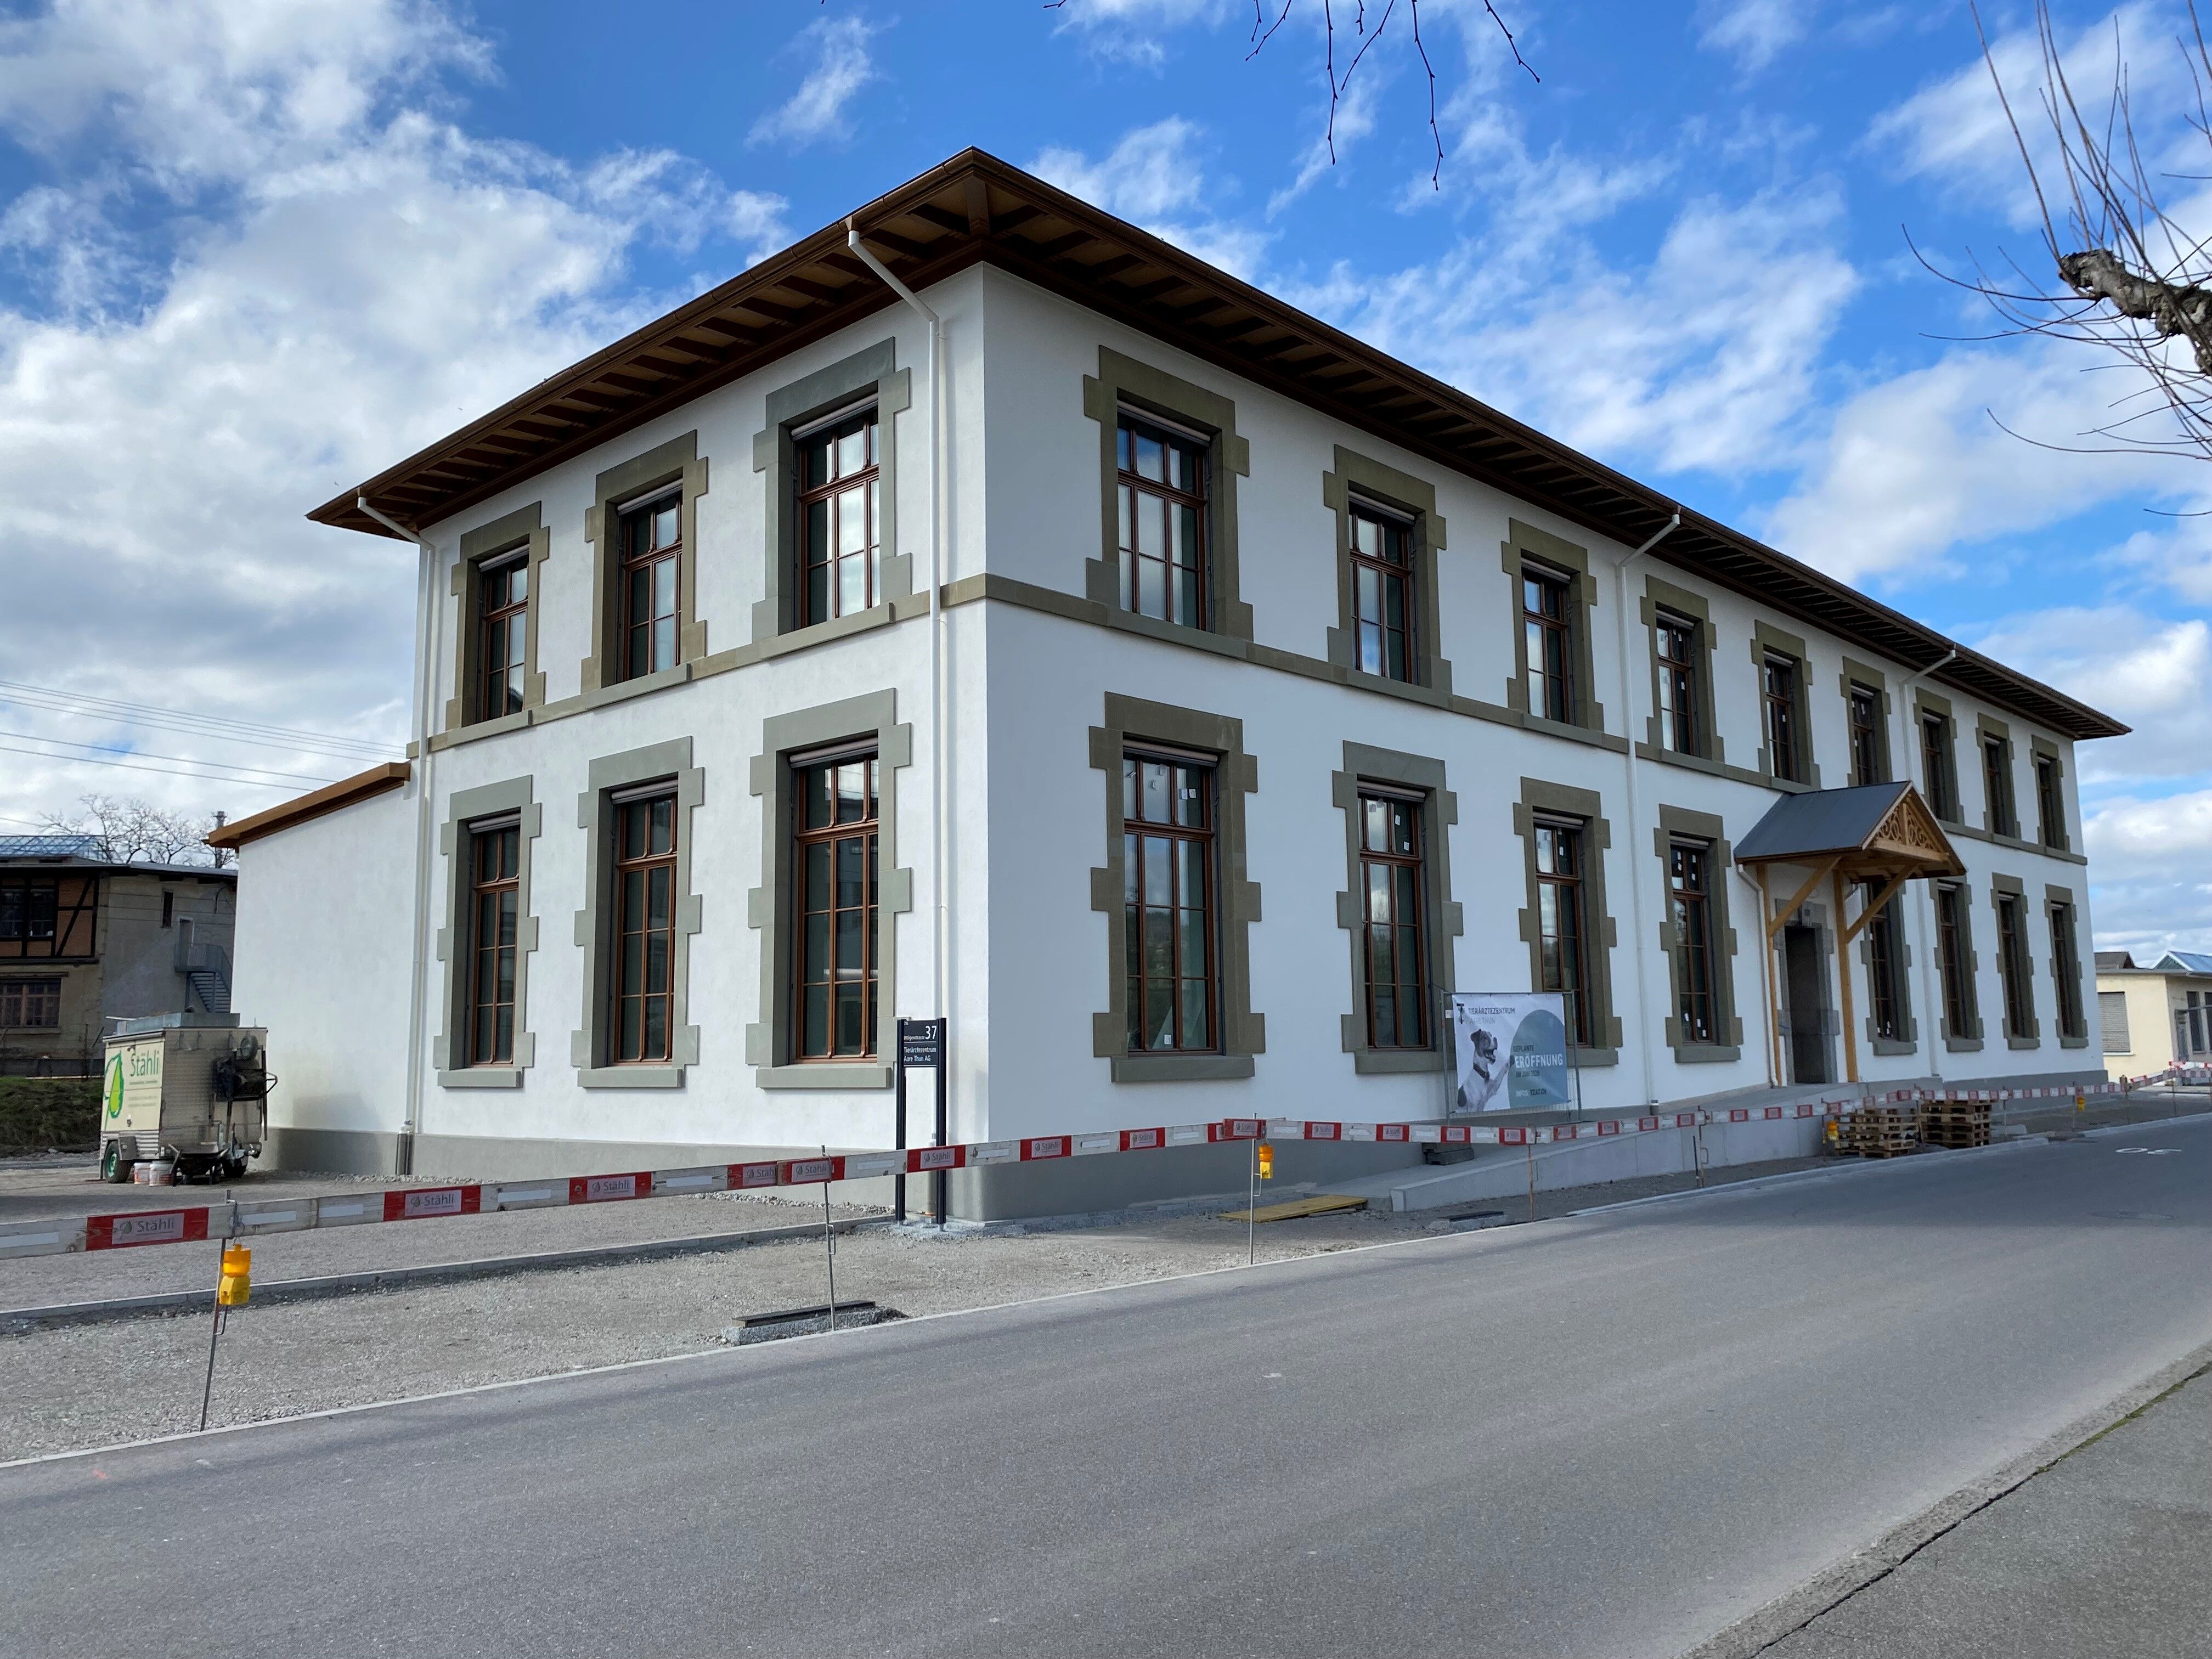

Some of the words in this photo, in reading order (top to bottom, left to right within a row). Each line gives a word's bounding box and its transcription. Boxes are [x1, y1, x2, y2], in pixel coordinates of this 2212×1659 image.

[925, 1025, 937, 1039] 37
[130, 1049, 160, 1076] Stähli
[1514, 1053, 1563, 1068] ERÖFFNUNG
[932, 1152, 951, 1161] Stähli
[805, 1163, 827, 1174] Stähli
[603, 1179, 629, 1191] Stähli
[424, 1193, 454, 1206] Stähli
[137, 1217, 175, 1233] Stähli
